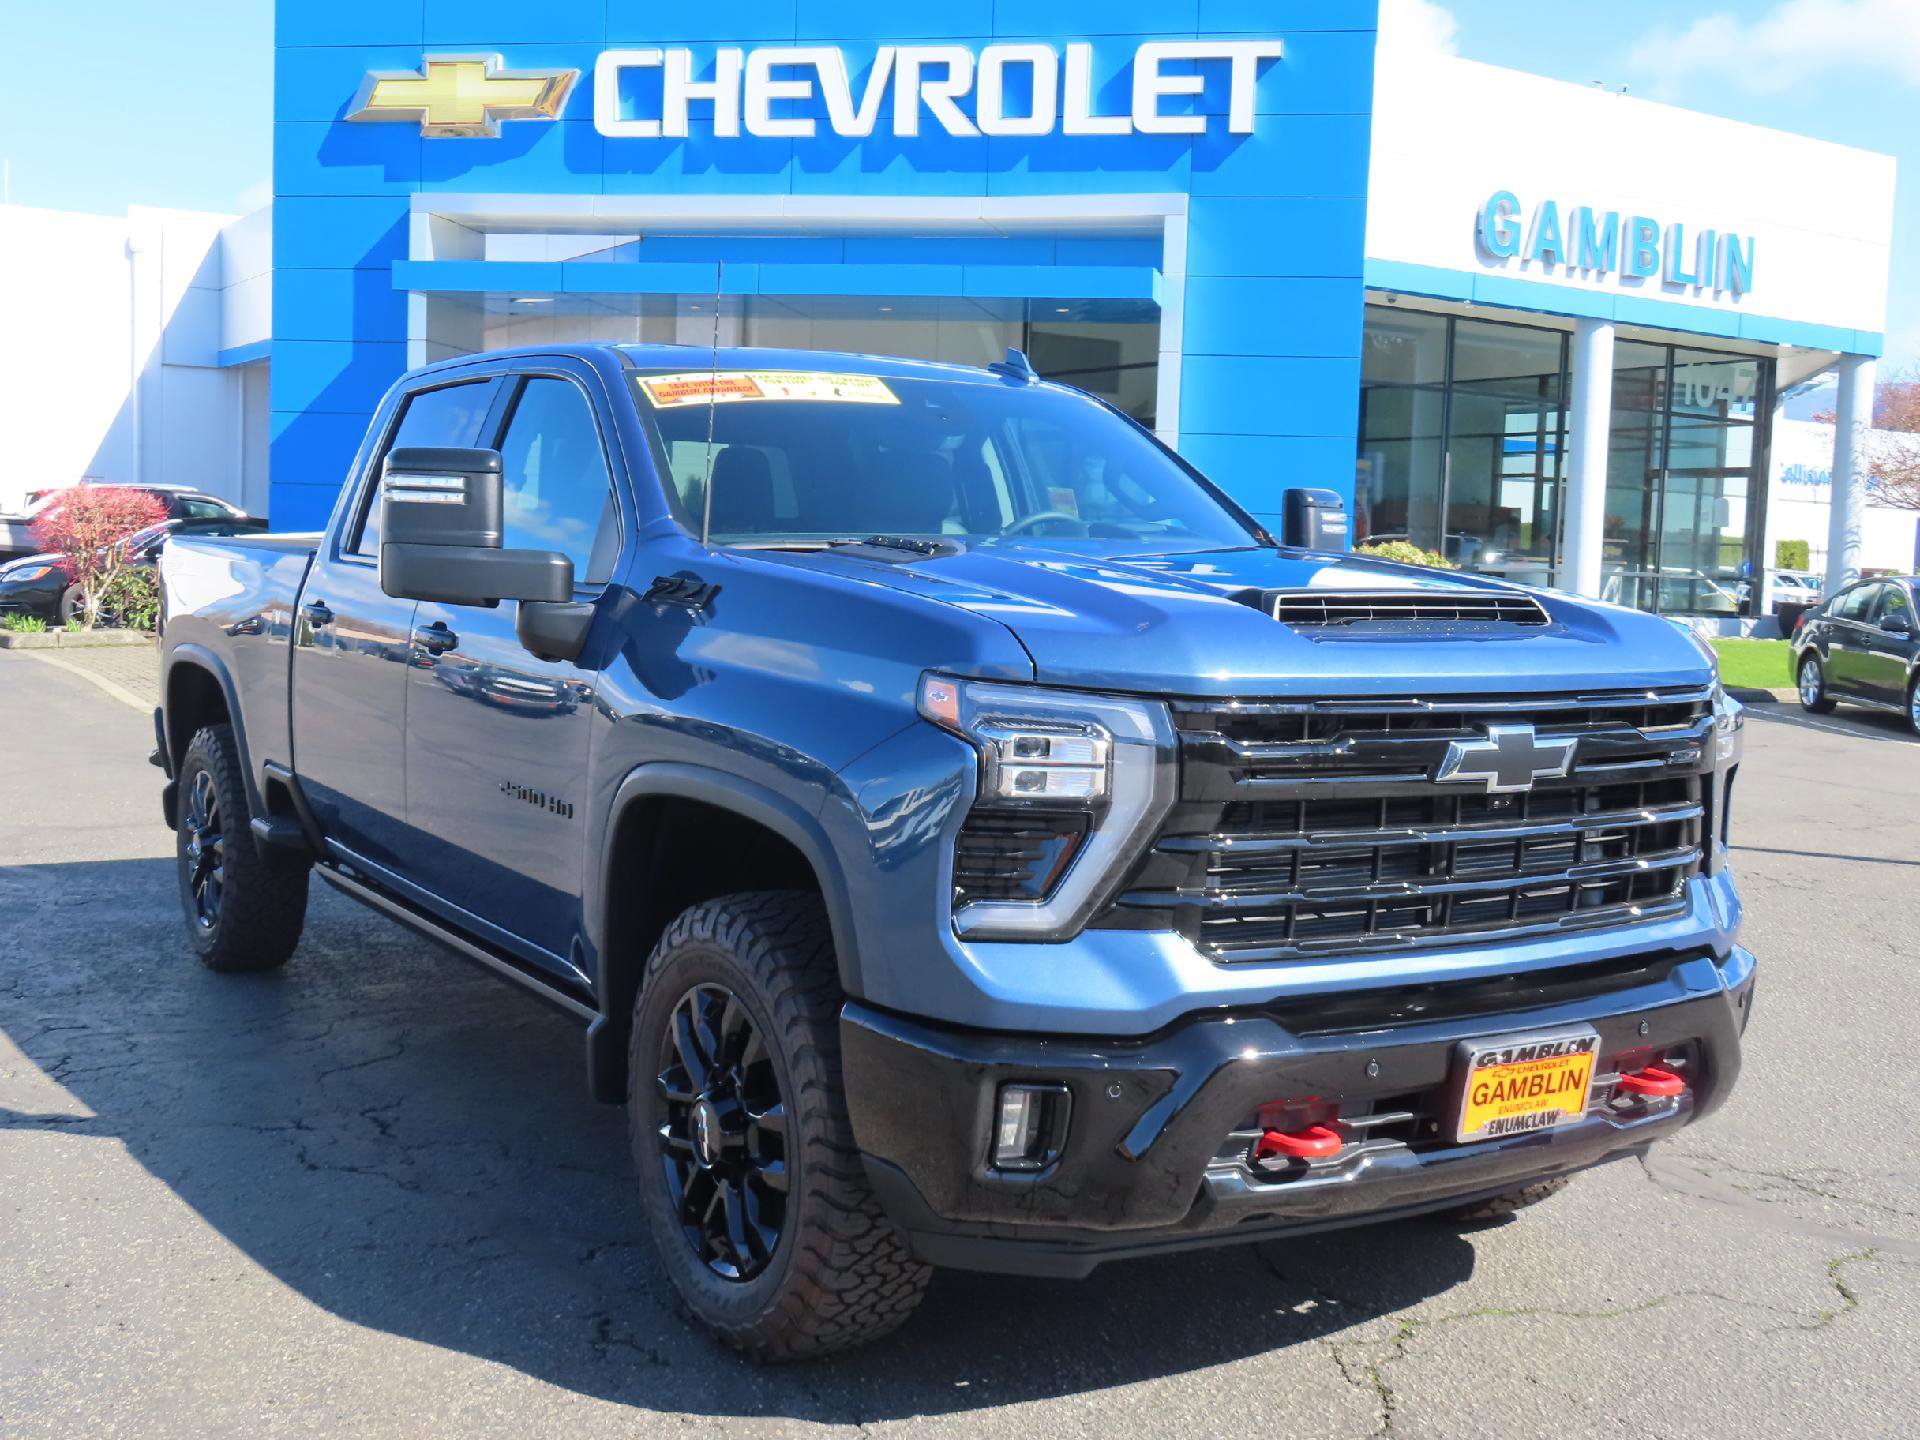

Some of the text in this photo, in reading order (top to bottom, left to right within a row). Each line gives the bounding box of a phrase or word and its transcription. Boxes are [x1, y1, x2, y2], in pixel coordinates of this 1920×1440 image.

[593, 39, 1284, 138] CHEVROLET
[1473, 190, 1755, 295] GAMBLIN
[658, 387, 701, 398] GAMBLIN
[1477, 1036, 1596, 1068] GAMBLIN
[1517, 1059, 1570, 1074] CHEVROLET
[1472, 1068, 1583, 1107] GAMBLIN
[1498, 1098, 1550, 1114] ENUMCLAW
[1488, 1111, 1560, 1135] ENUMCLAW
